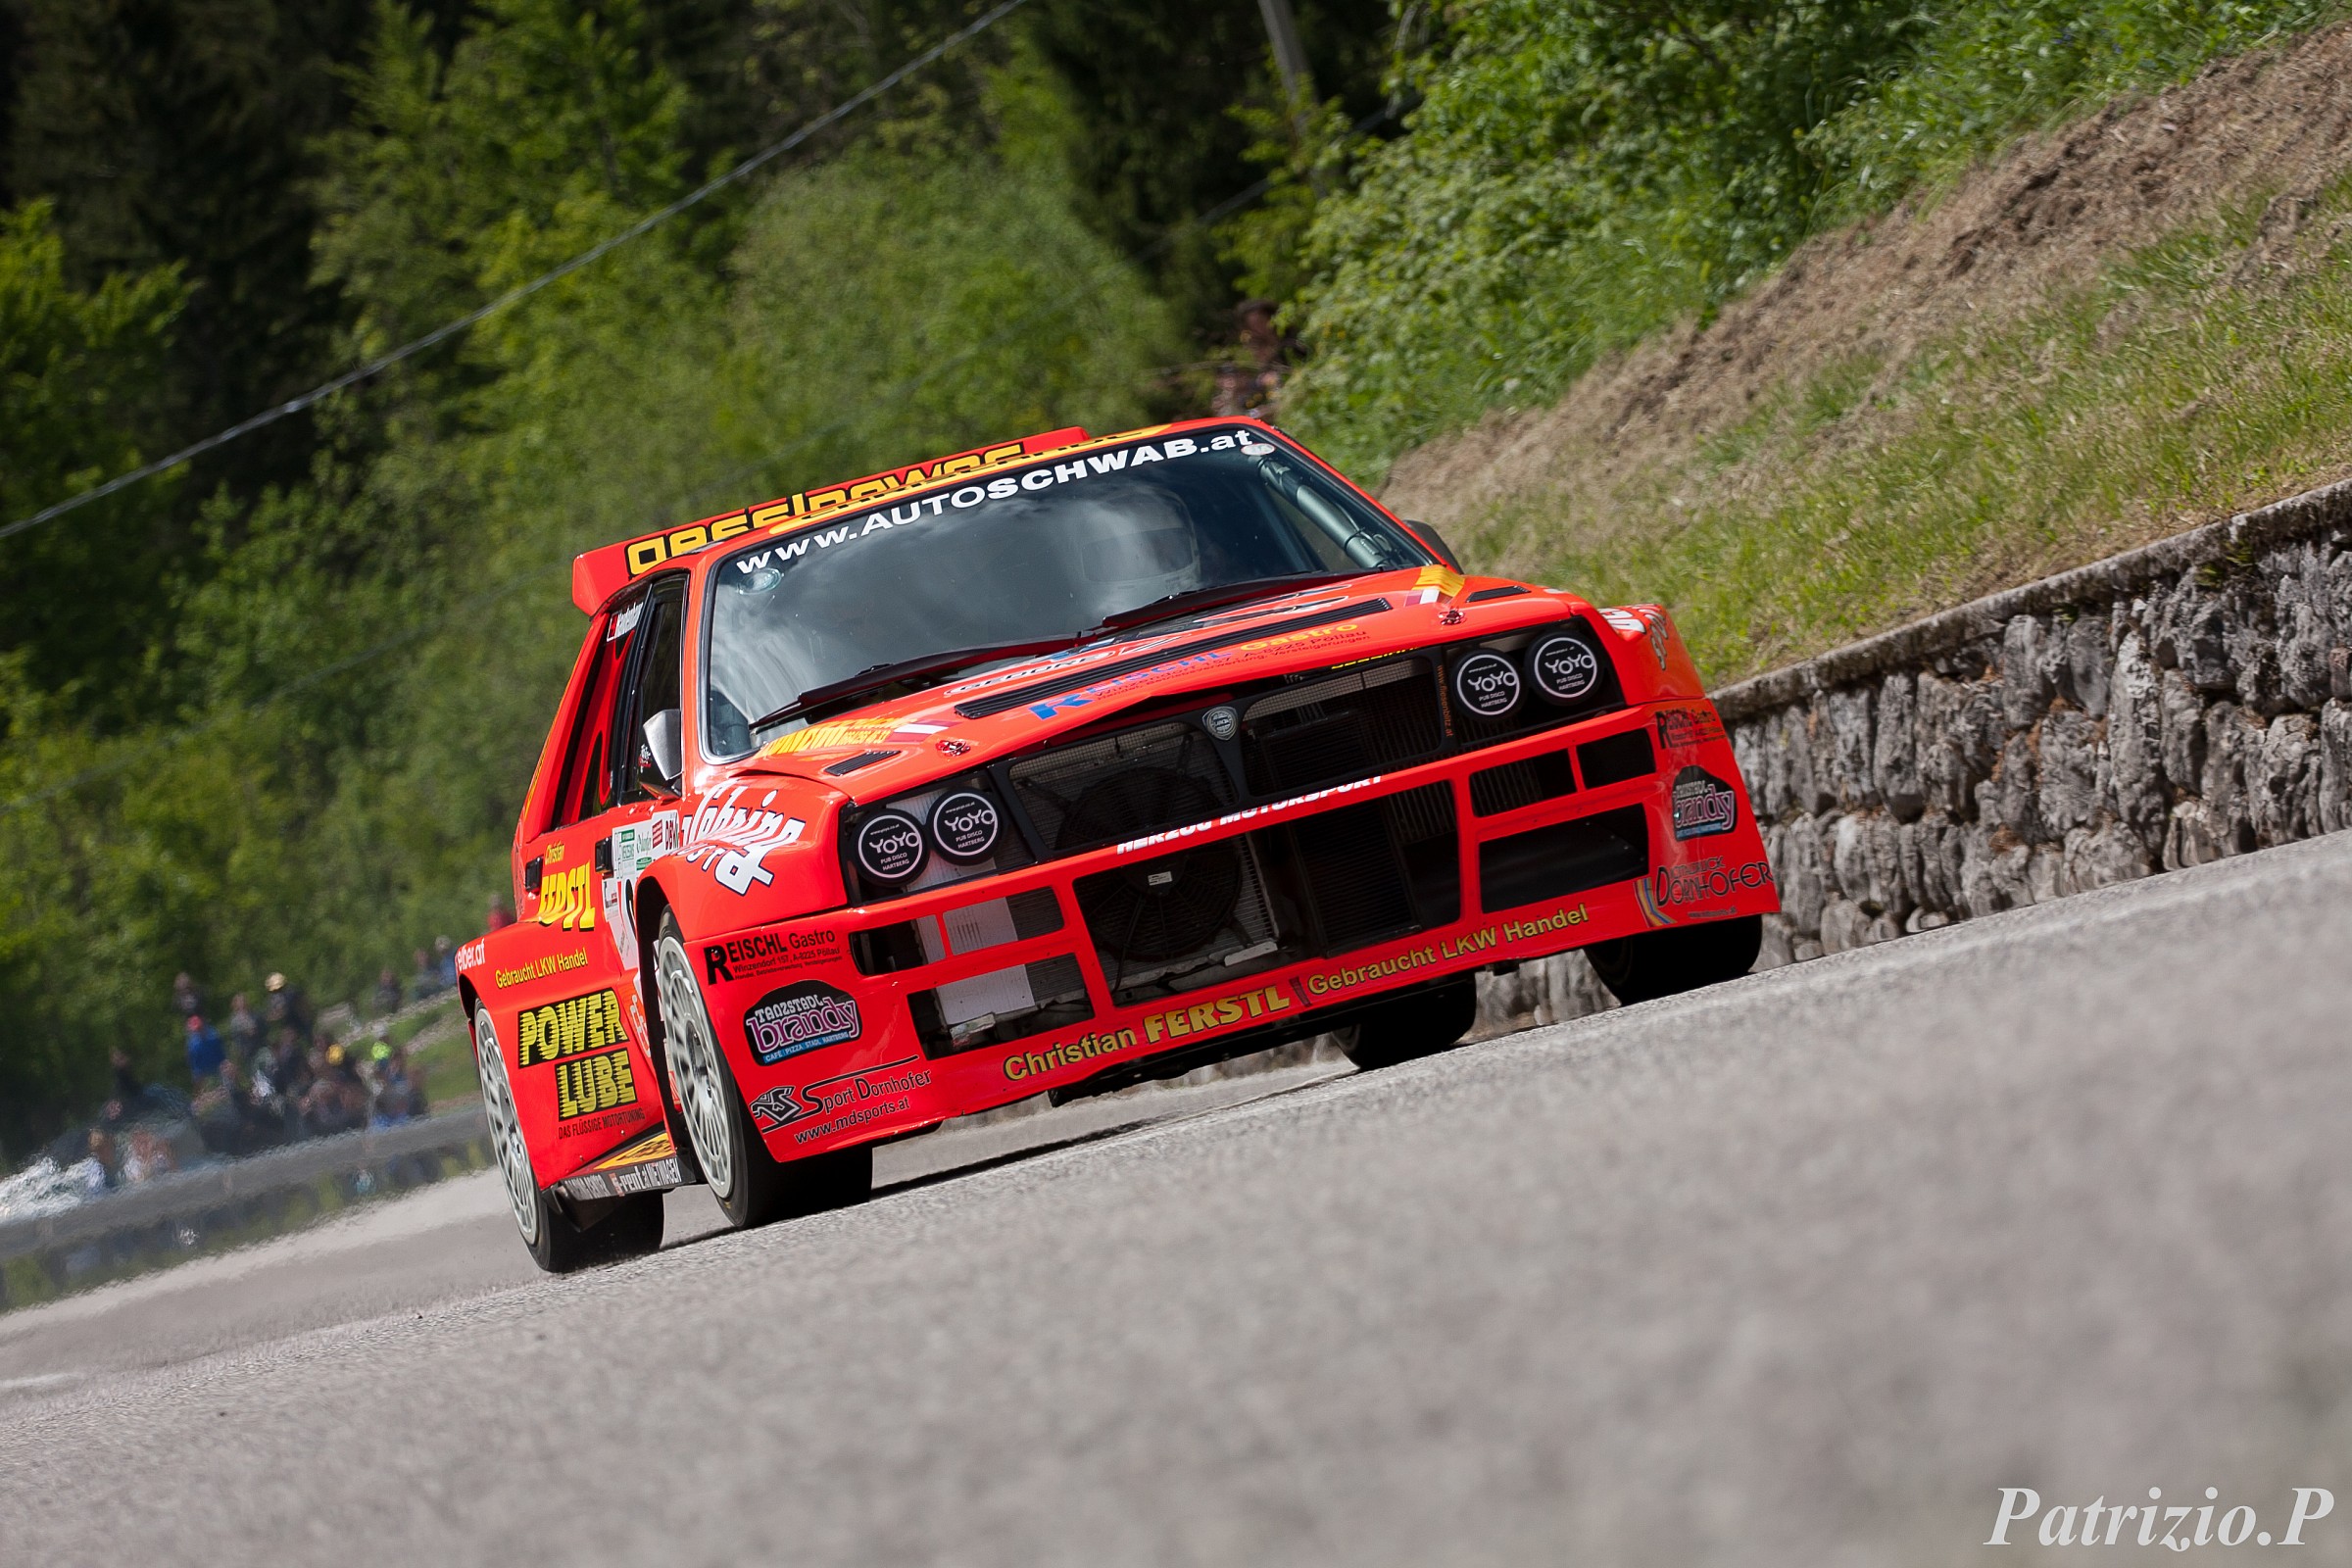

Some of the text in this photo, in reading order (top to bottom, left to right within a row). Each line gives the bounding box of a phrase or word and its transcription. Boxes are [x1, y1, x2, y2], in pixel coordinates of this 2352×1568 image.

[737, 429, 1252, 574] www.AUTOSCHWAB.at
[1241, 624, 1357, 651] Gastro
[1467, 670, 1517, 692] YOYO
[1544, 653, 1594, 675] YOYO
[869, 831, 920, 855] YOYO
[944, 808, 995, 832] YOYO
[495, 947, 588, 990] Gebraucht LKW Handel
[704, 930, 836, 986] REISCHL Gastro
[733, 956, 776, 973] Winzendorf
[1307, 904, 1591, 996] Gebraucht LKW Handel
[519, 989, 629, 1066] POWER
[746, 997, 859, 1054] brandy
[1003, 984, 1292, 1080] Christian FERSTL
[784, 1044, 805, 1056] PIZZA
[558, 1050, 637, 1119] LUBE
[801, 1069, 932, 1119] Sport Dornhofer
[558, 1125, 571, 1140] DAS
[571, 1118, 602, 1137] FLÜSSIGE
[794, 1096, 910, 1145] www.mdsports.at
